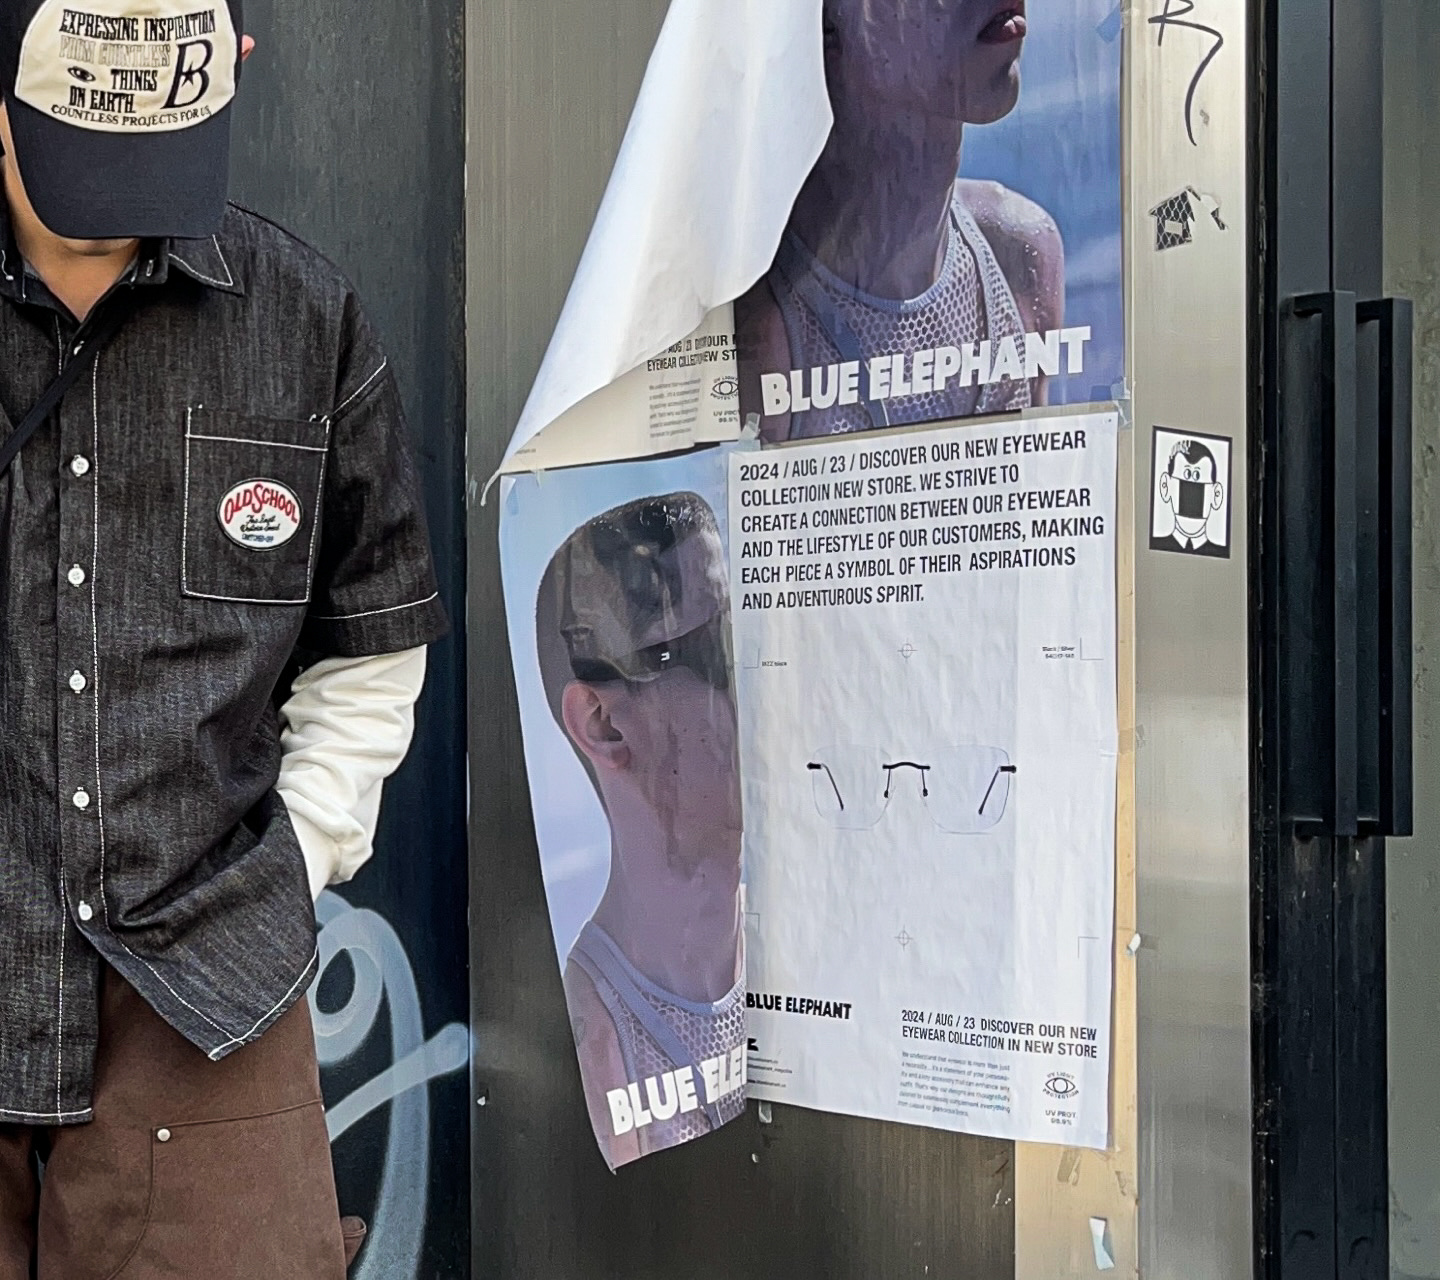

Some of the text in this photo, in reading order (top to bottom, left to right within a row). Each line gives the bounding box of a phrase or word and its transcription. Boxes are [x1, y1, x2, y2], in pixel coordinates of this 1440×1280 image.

[59, 9, 217, 42] EXPRESSING INSPIRATION
[59, 35, 171, 68] FROM COUNTLESS
[110, 69, 158, 92] THINGS
[160, 39, 214, 110] B
[69, 85, 86, 109] ON
[51, 104, 119, 125] COUNTLESS
[121, 111, 179, 127] PROJECTS
[180, 109, 199, 122] FOR
[760, 360, 860, 417] BLUE
[869, 326, 1091, 401] ELEPHANT
[740, 463, 779, 481] 2024
[791, 458, 817, 477] AUG
[830, 455, 846, 474] 23
[860, 445, 927, 470] DISCOVER
[931, 442, 960, 462] OUR
[965, 437, 998, 459] NEW
[1002, 430, 1086, 455] EYEWEAR
[741, 464, 1019, 507] COLLECTIOIN NEW STORE. WE STRIVE TO
[741, 487, 1091, 533] CREATE A CONNECTION BETWEEN OUR EYEWEAR
[741, 516, 1104, 558] AND THE LIFESTYLE OF OUR CUSTOMERS, MAKING
[742, 546, 1076, 584] EACH PIECE A SYMBOL OF THEIR ASPIRATIONS
[742, 584, 924, 610] AND ADVENTUROUS SPIRIT.
[746, 992, 852, 1020] BLUE ELEPHANT
[901, 1010, 924, 1024] 2024
[935, 1013, 954, 1027] AUG
[963, 1018, 976, 1030] 23
[980, 1018, 1034, 1036] DISCOVER
[1039, 1024, 1065, 1039] OUR
[1070, 1026, 1097, 1041] NEW
[902, 1025, 1098, 1059] EYEWEAR COLLECTION IN NEW STORE
[607, 1043, 747, 1136] BLUE ELE
